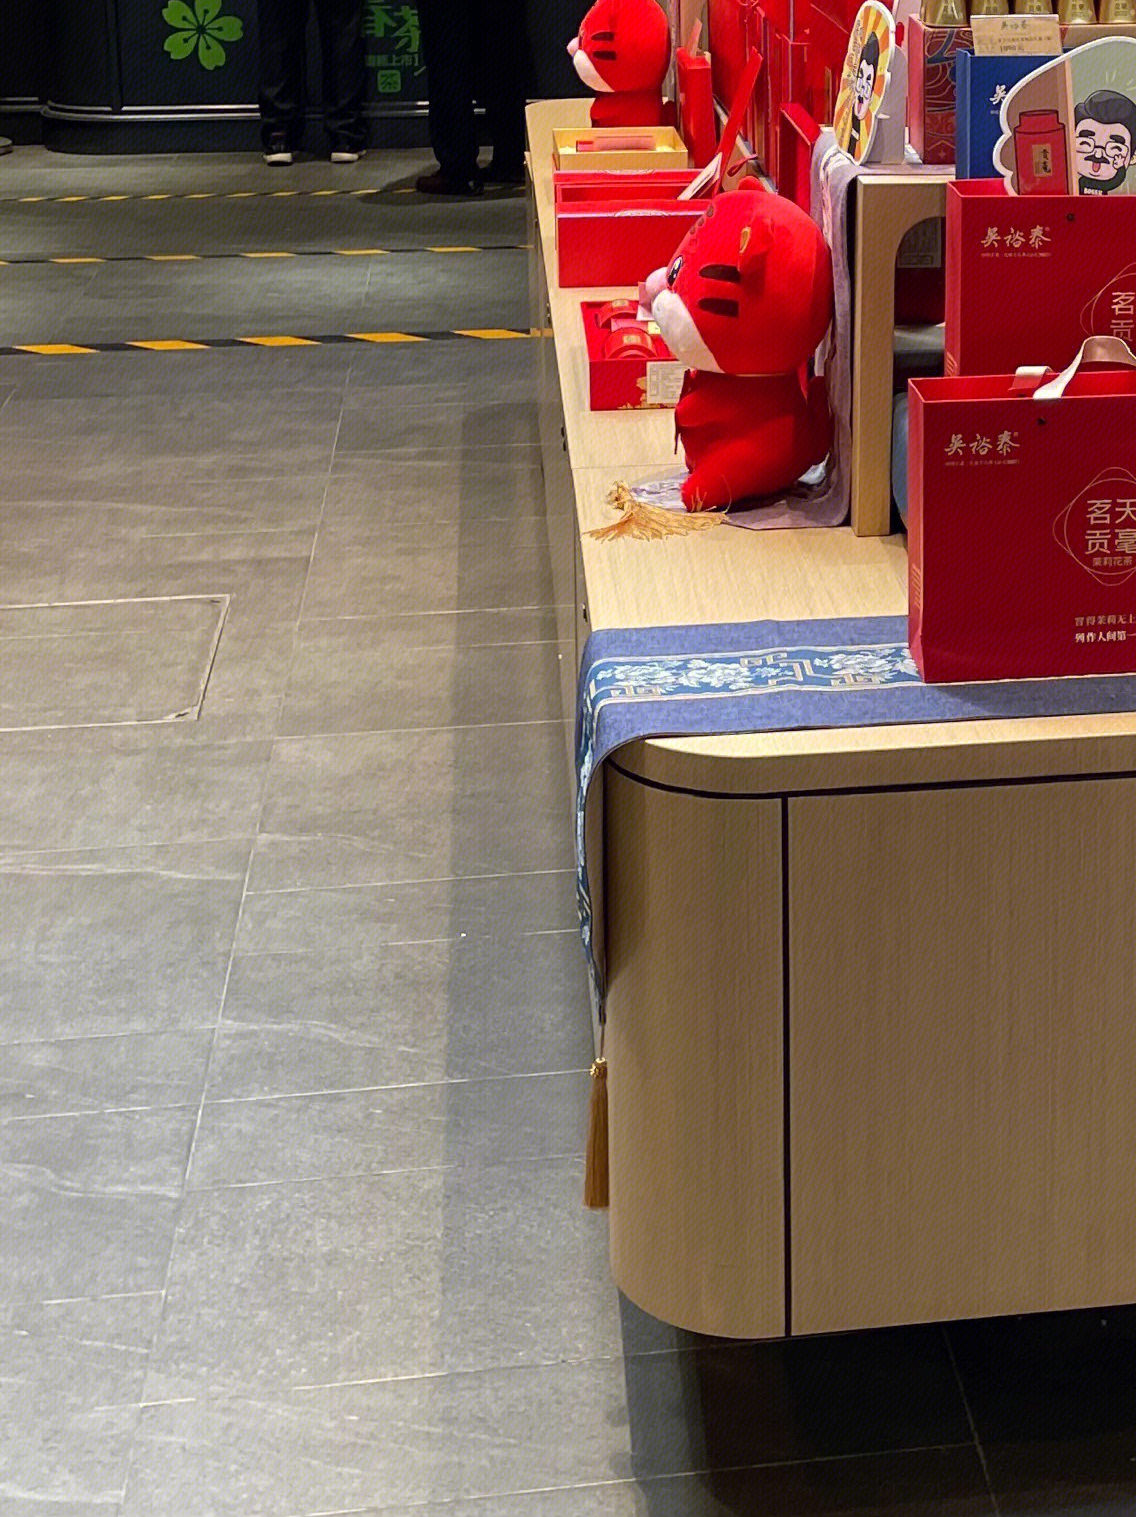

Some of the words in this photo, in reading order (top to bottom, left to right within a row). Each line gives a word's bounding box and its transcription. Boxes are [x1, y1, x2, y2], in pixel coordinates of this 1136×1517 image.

[980, 225, 1052, 250] 吴裕泰
[944, 429, 1020, 457] 吴裕泰
